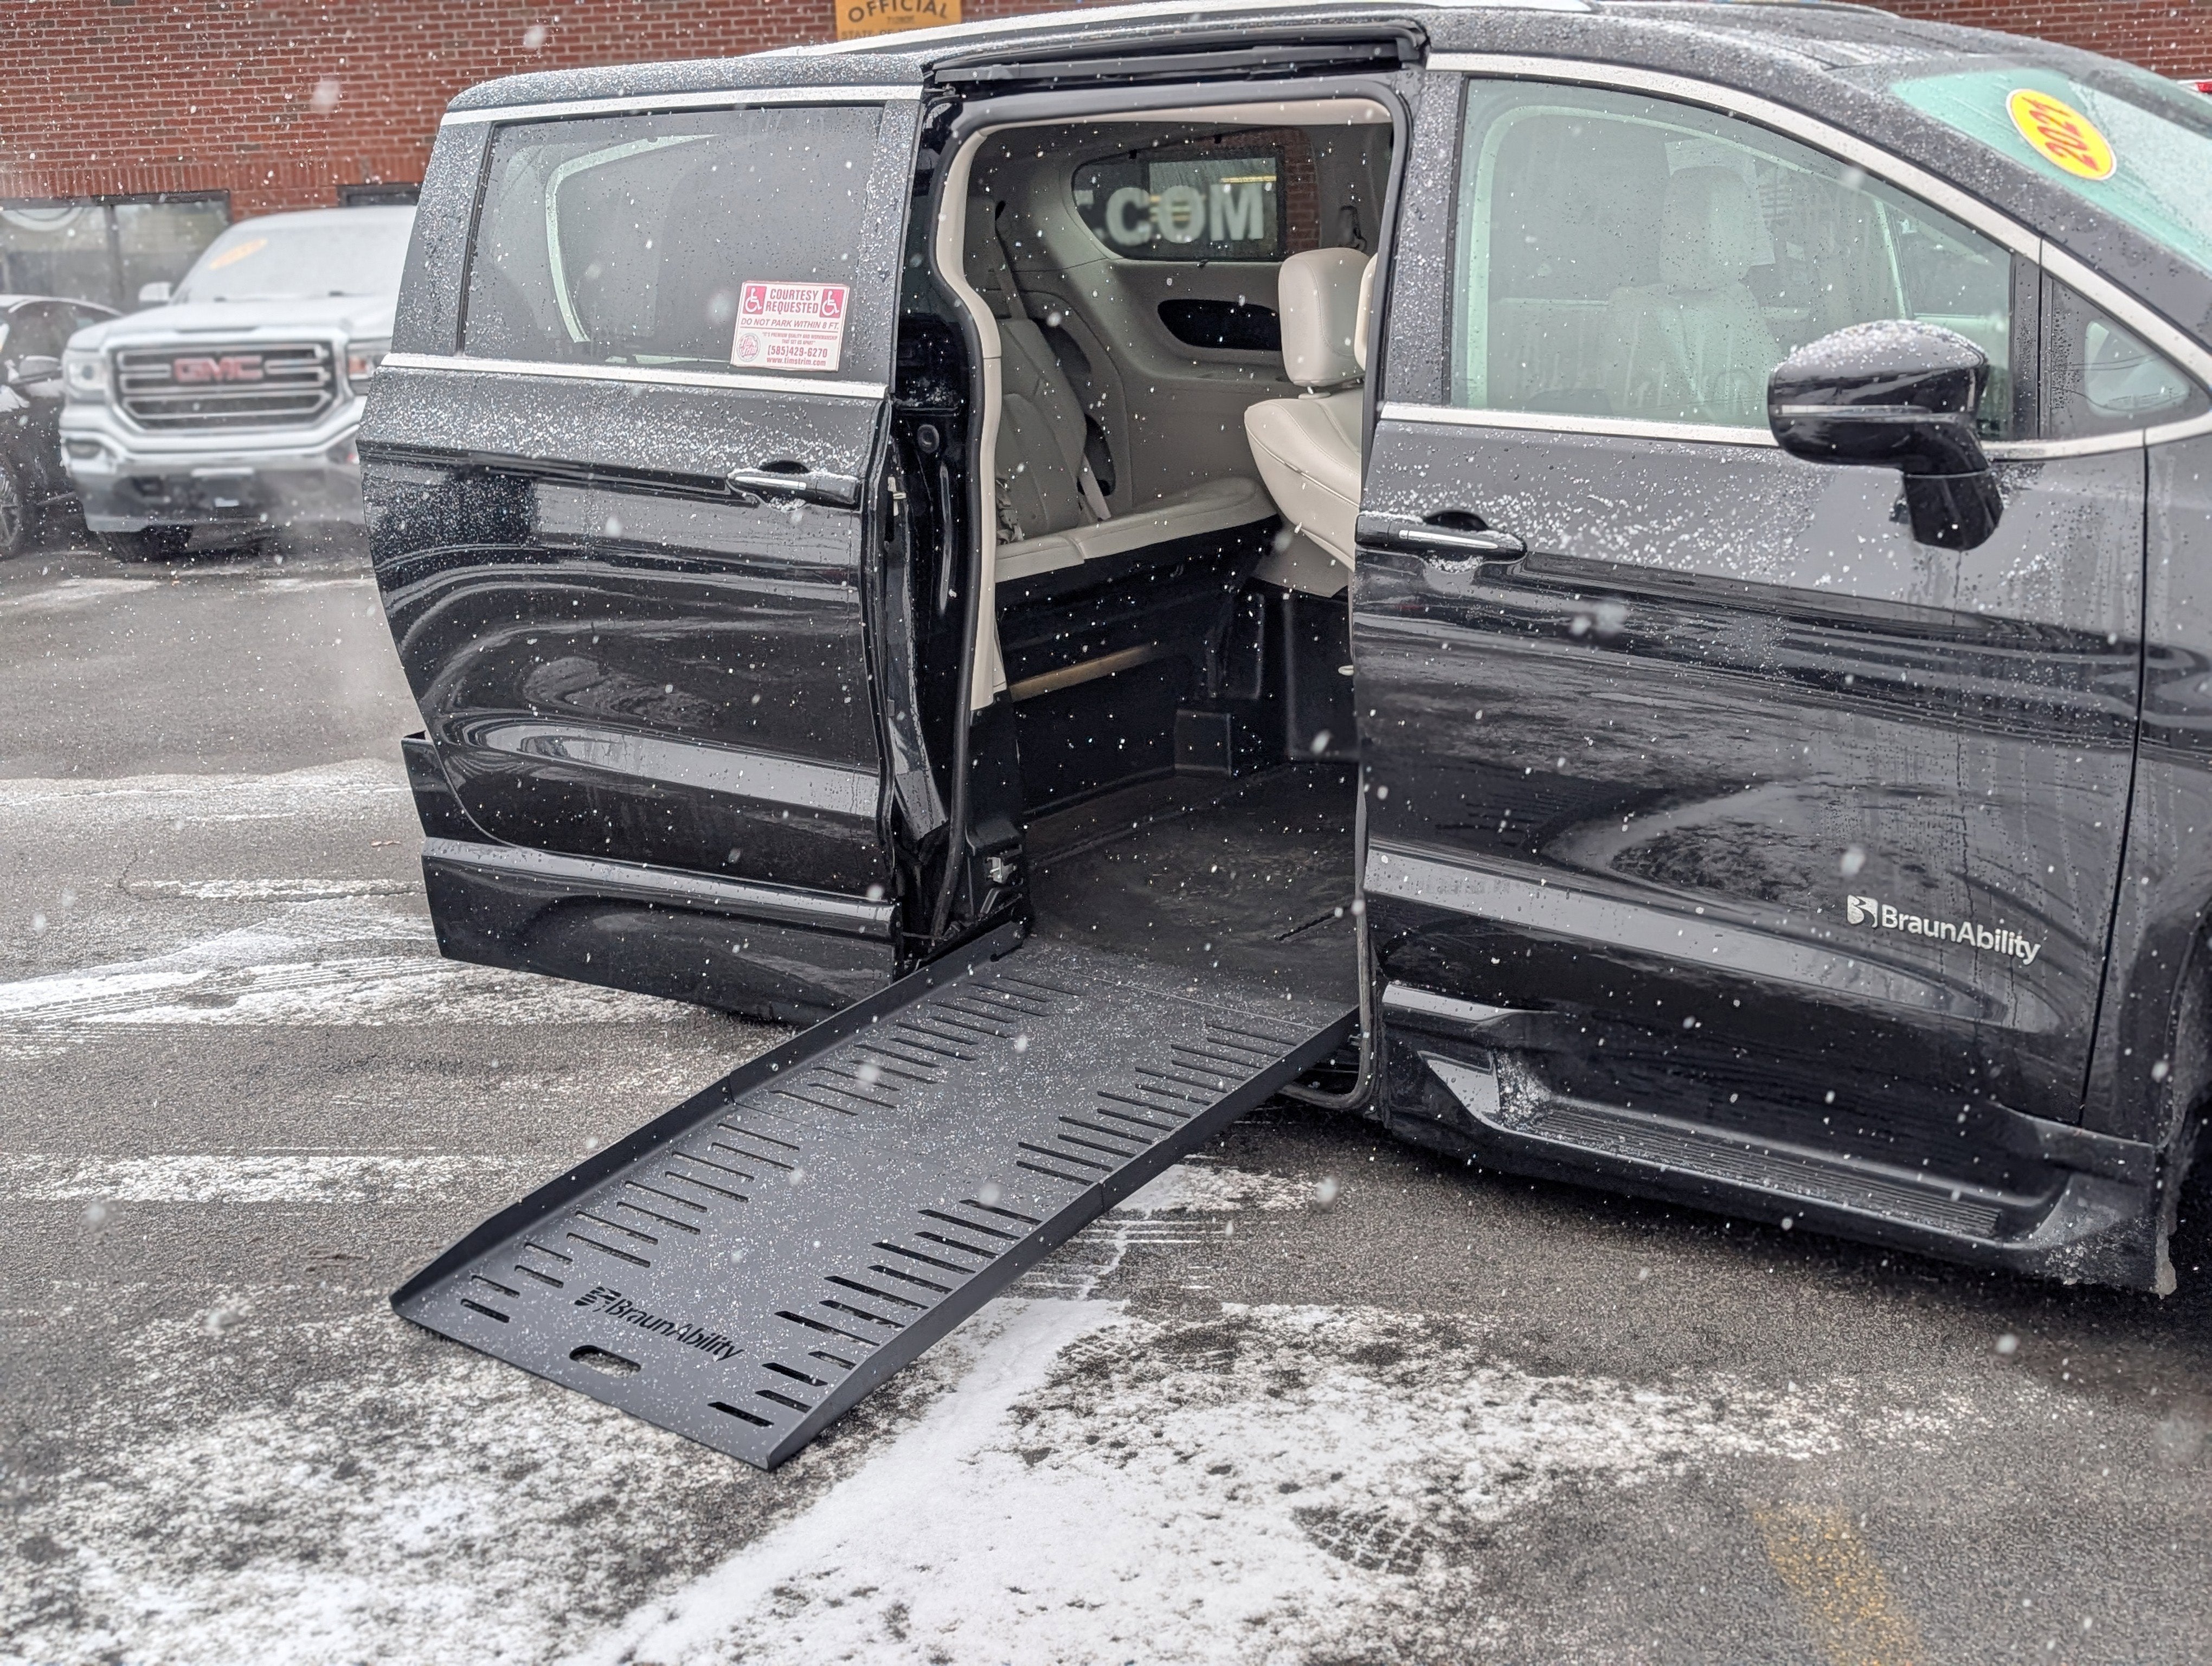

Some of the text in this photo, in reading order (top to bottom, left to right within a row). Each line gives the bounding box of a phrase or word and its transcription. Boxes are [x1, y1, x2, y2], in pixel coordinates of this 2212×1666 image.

[848, 0, 947, 23] OFFICIAL
[2022, 97, 2100, 171] 2021
[770, 289, 819, 301] COURTESY
[765, 301, 819, 315] REQUESTED
[794, 321, 821, 329] WITHIN
[768, 345, 828, 358] (585)429-6270
[174, 355, 263, 382] GMC
[767, 357, 826, 366] www.timstrim.com
[1881, 904, 2041, 965] BraunAbility
[605, 1298, 745, 1362] BraunAbility
